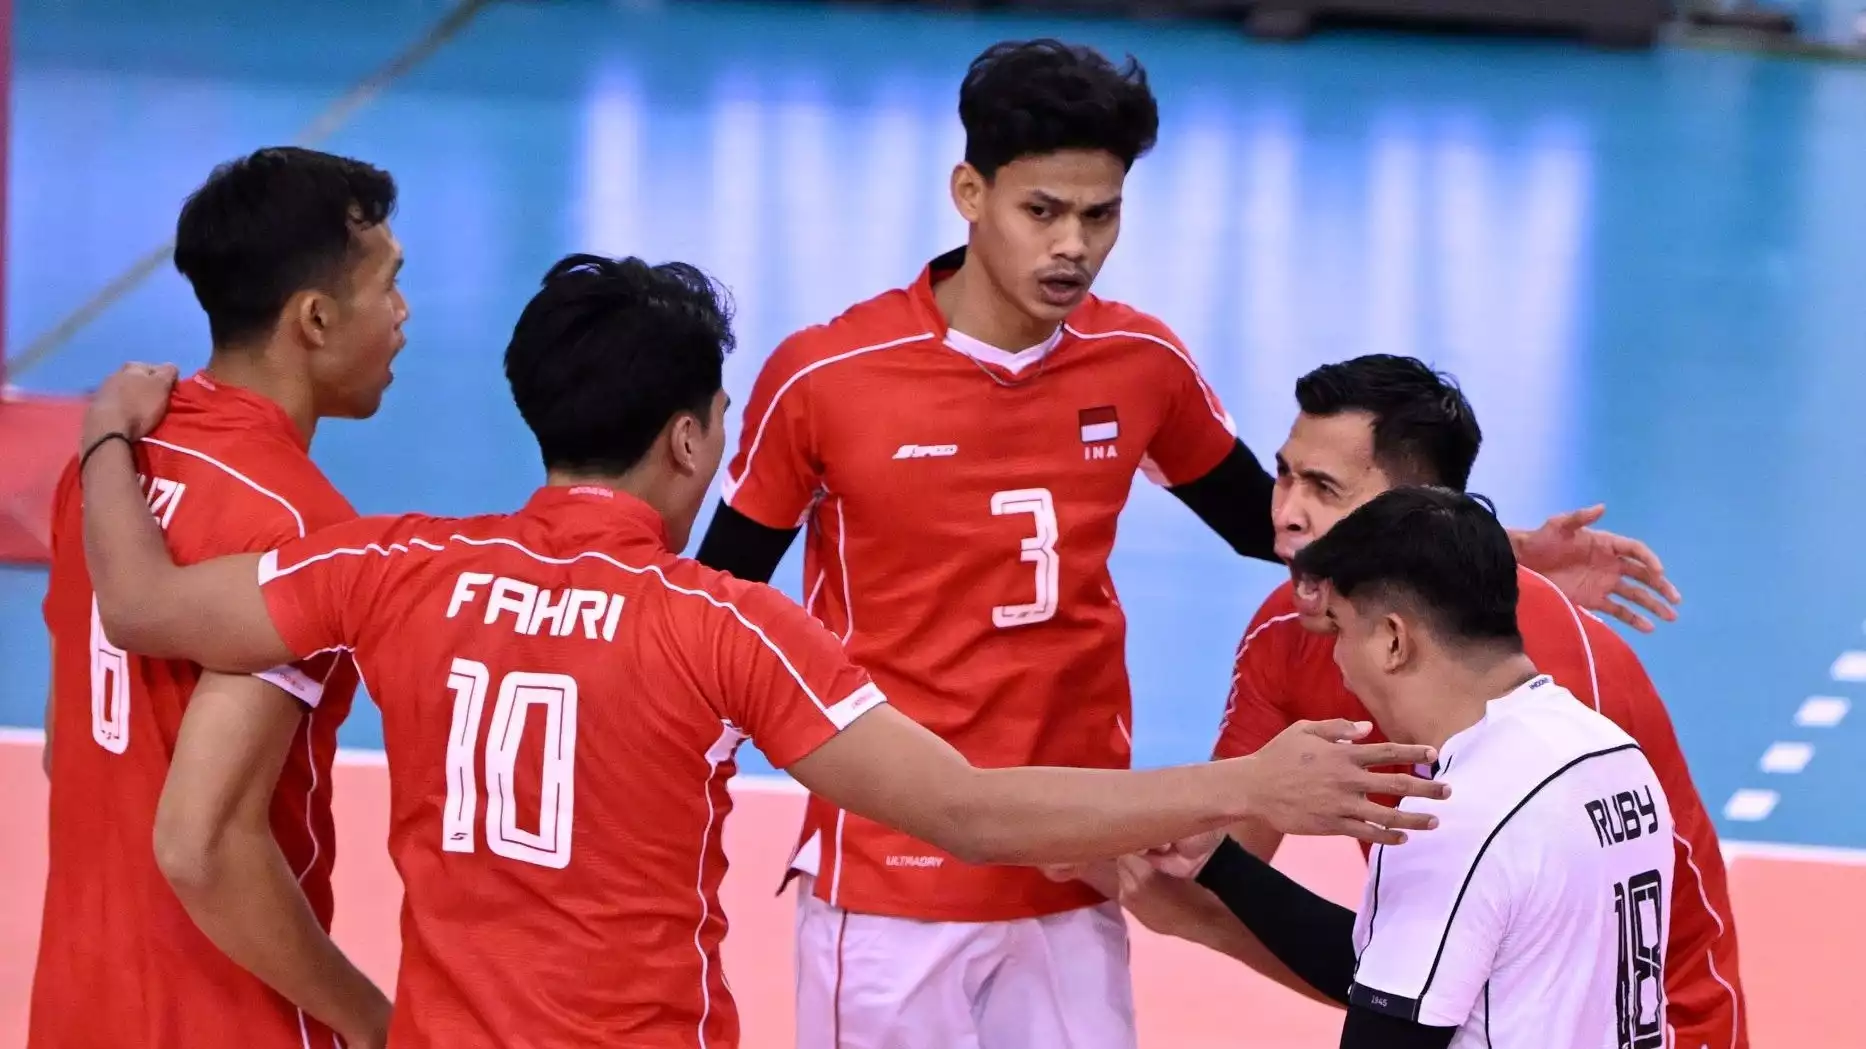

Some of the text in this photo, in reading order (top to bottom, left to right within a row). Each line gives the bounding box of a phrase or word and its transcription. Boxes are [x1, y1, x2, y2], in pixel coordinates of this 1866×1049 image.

[1084, 444, 1118, 461] INA
[990, 487, 1060, 628] 3
[446, 571, 625, 642] FAHRI
[442, 657, 578, 870] 10
[1584, 784, 1659, 849] RUBY
[1613, 868, 1663, 1049] 18
[1371, 994, 1388, 1008] 1945
